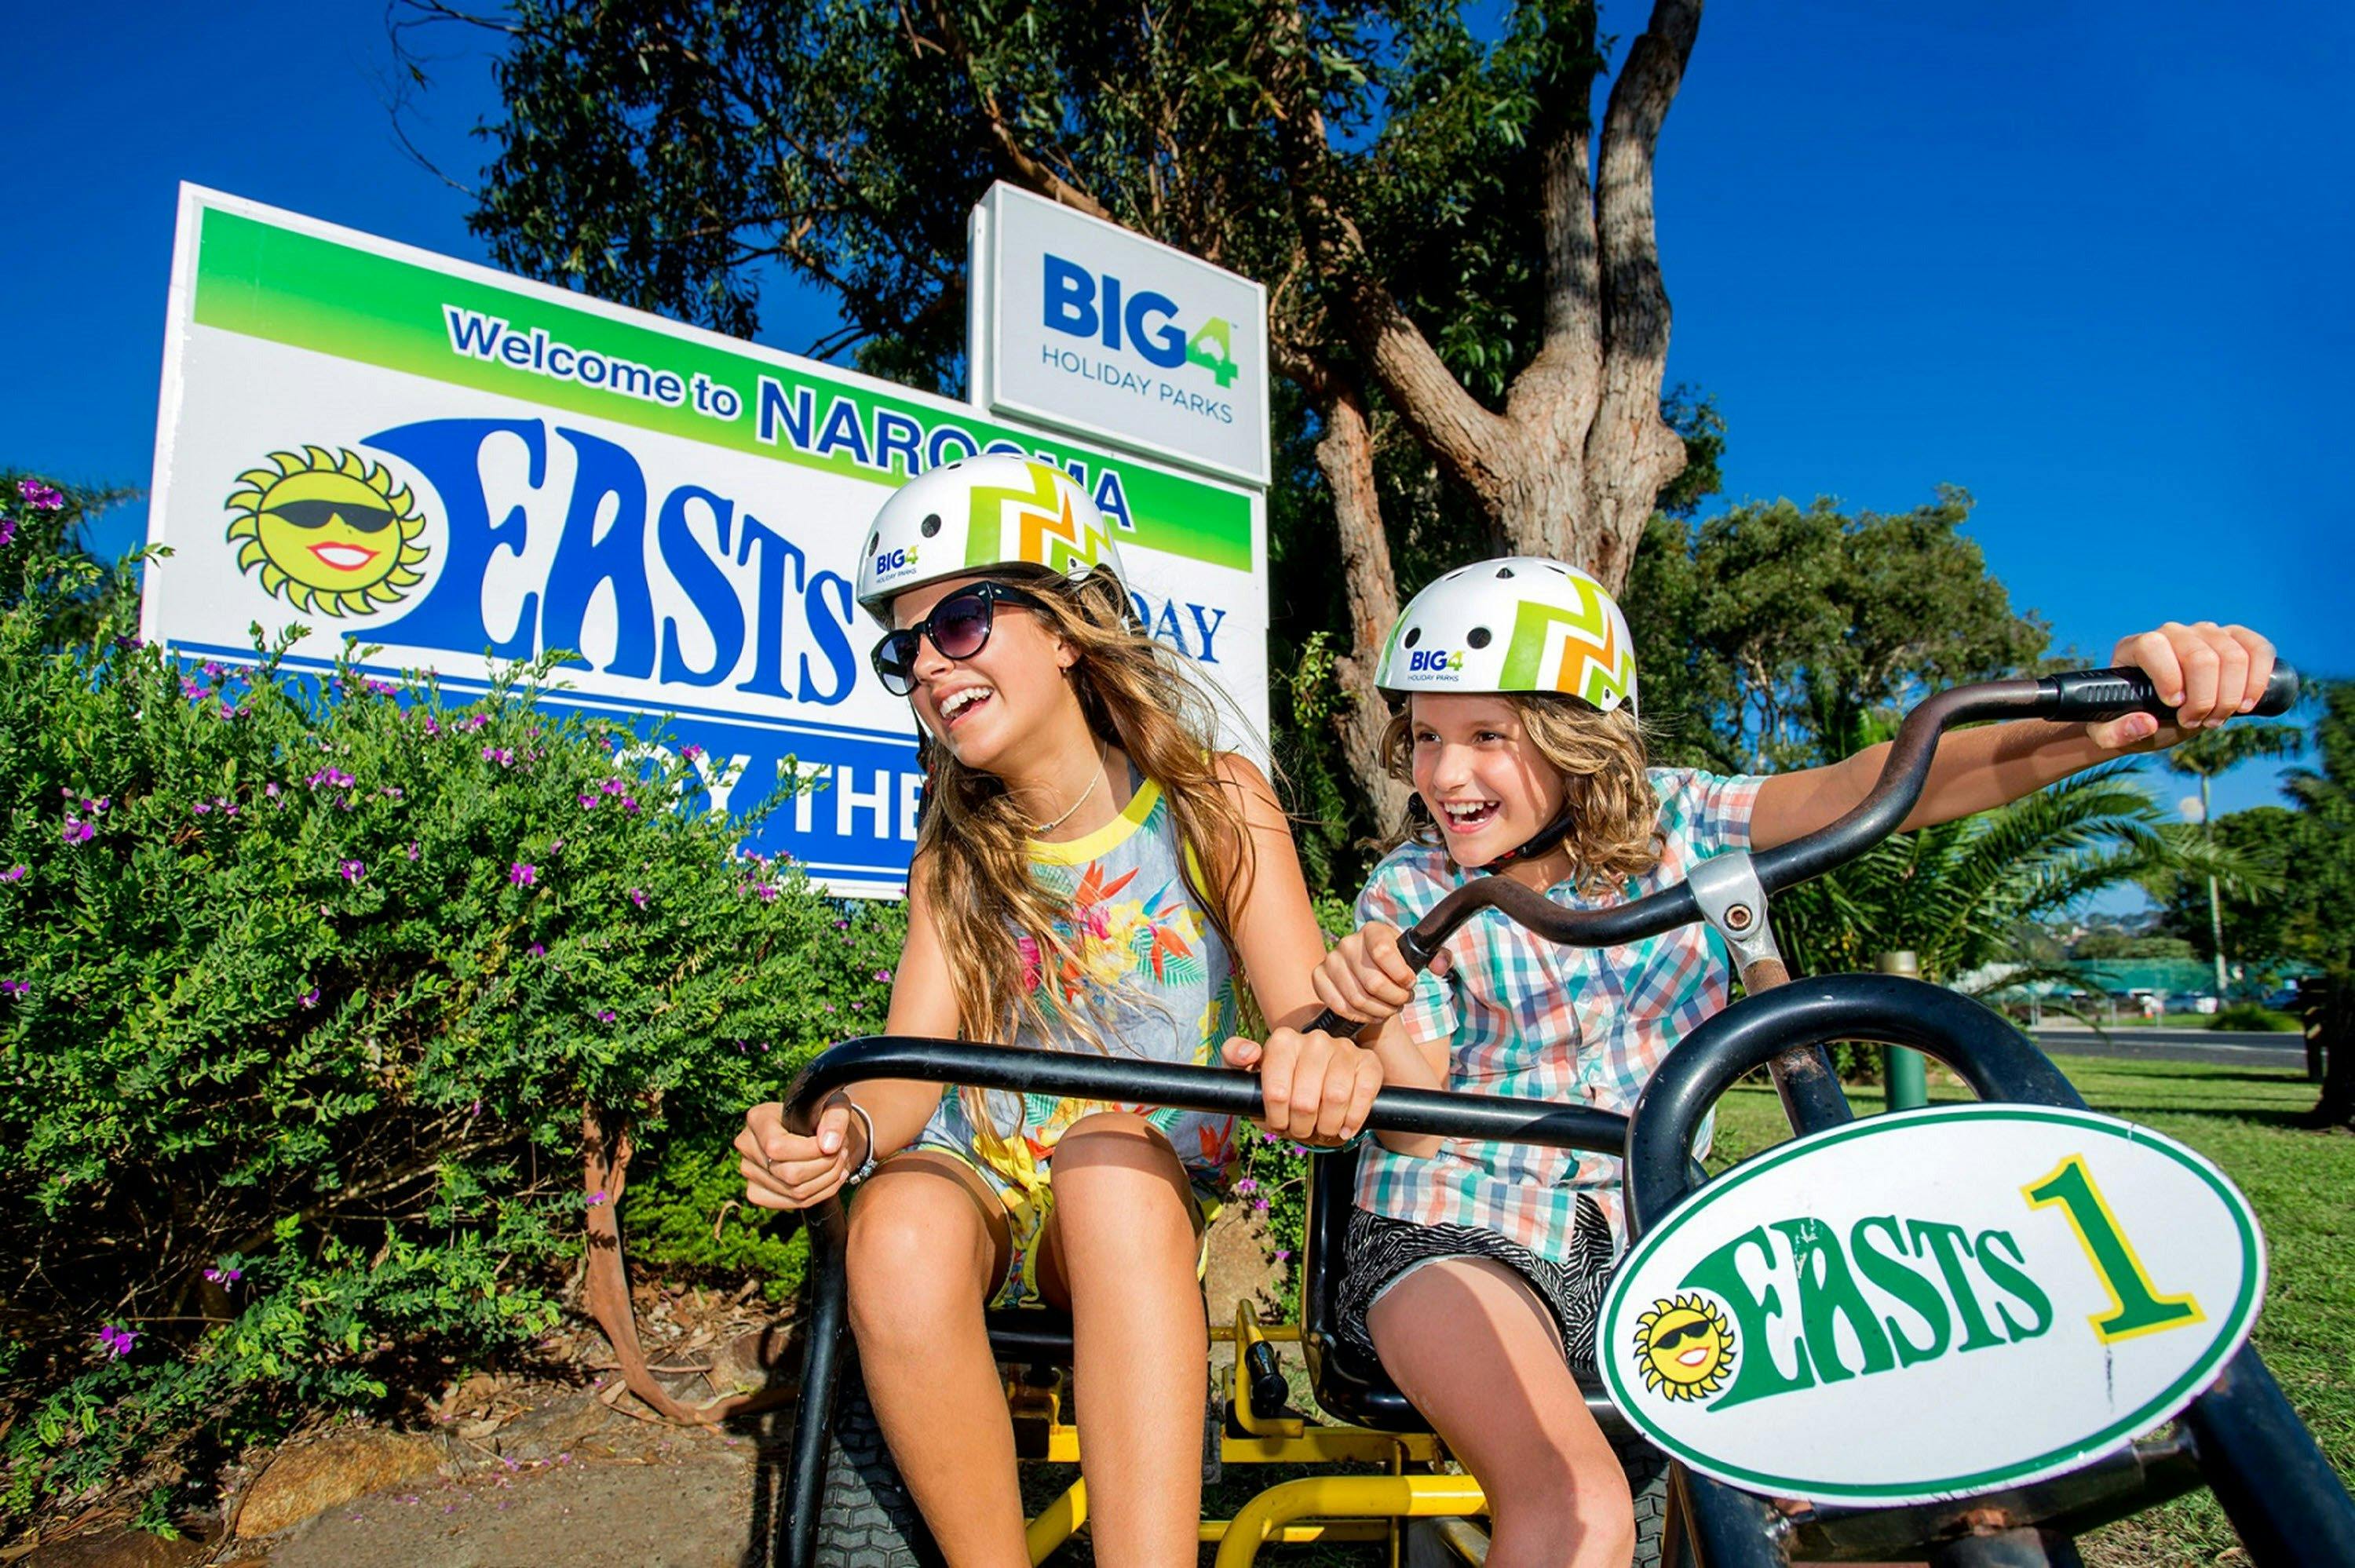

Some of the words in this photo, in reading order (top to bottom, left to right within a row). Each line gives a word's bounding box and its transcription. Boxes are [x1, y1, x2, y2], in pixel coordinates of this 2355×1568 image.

[1042, 344, 1152, 396] HOLIDAY
[1159, 382, 1233, 424] PARKS
[1043, 252, 1239, 389] BIG4
[444, 307, 684, 405] Welcome
[692, 375, 742, 420] to
[758, 377, 1134, 531] NAROA
[341, 418, 858, 706] EASTS
[876, 545, 918, 575] BIG4
[1410, 650, 1463, 672] BIG4
[1678, 1215, 2053, 1413] EASTS
[2020, 1152, 2207, 1344] 1
